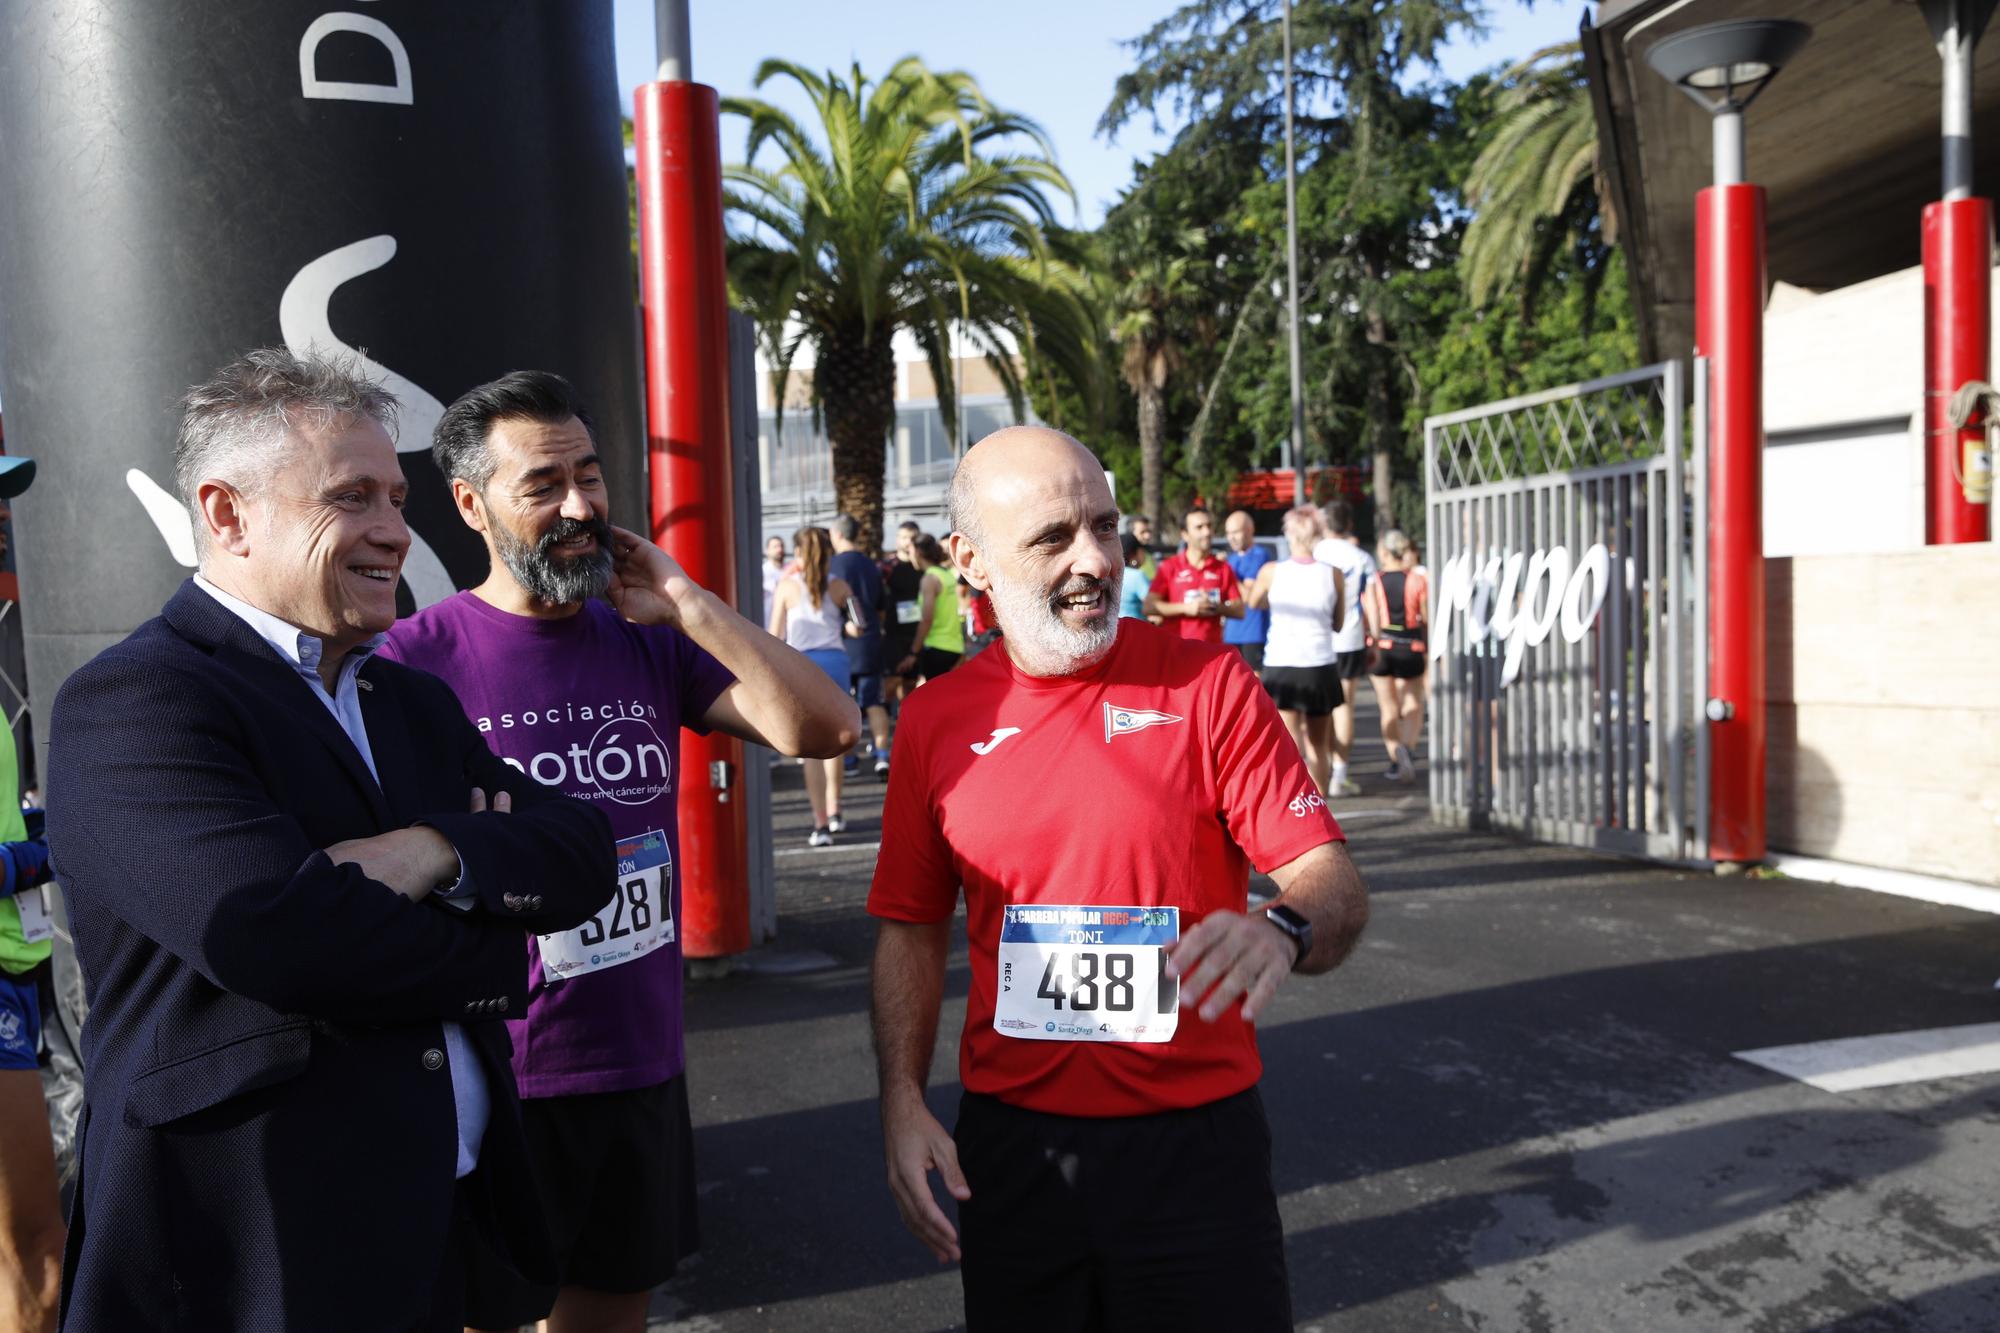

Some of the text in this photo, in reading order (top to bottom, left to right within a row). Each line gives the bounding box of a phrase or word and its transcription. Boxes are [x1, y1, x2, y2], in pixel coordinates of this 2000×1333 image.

[477, 700, 657, 732] asociación
[615, 785, 646, 797] cáncer
[1018, 910, 1060, 925] CARRERA
[1060, 910, 1101, 925] POPULAR
[1068, 930, 1104, 944] TONI
[1004, 962, 1012, 983] REC
[1037, 952, 1134, 1012] 488
